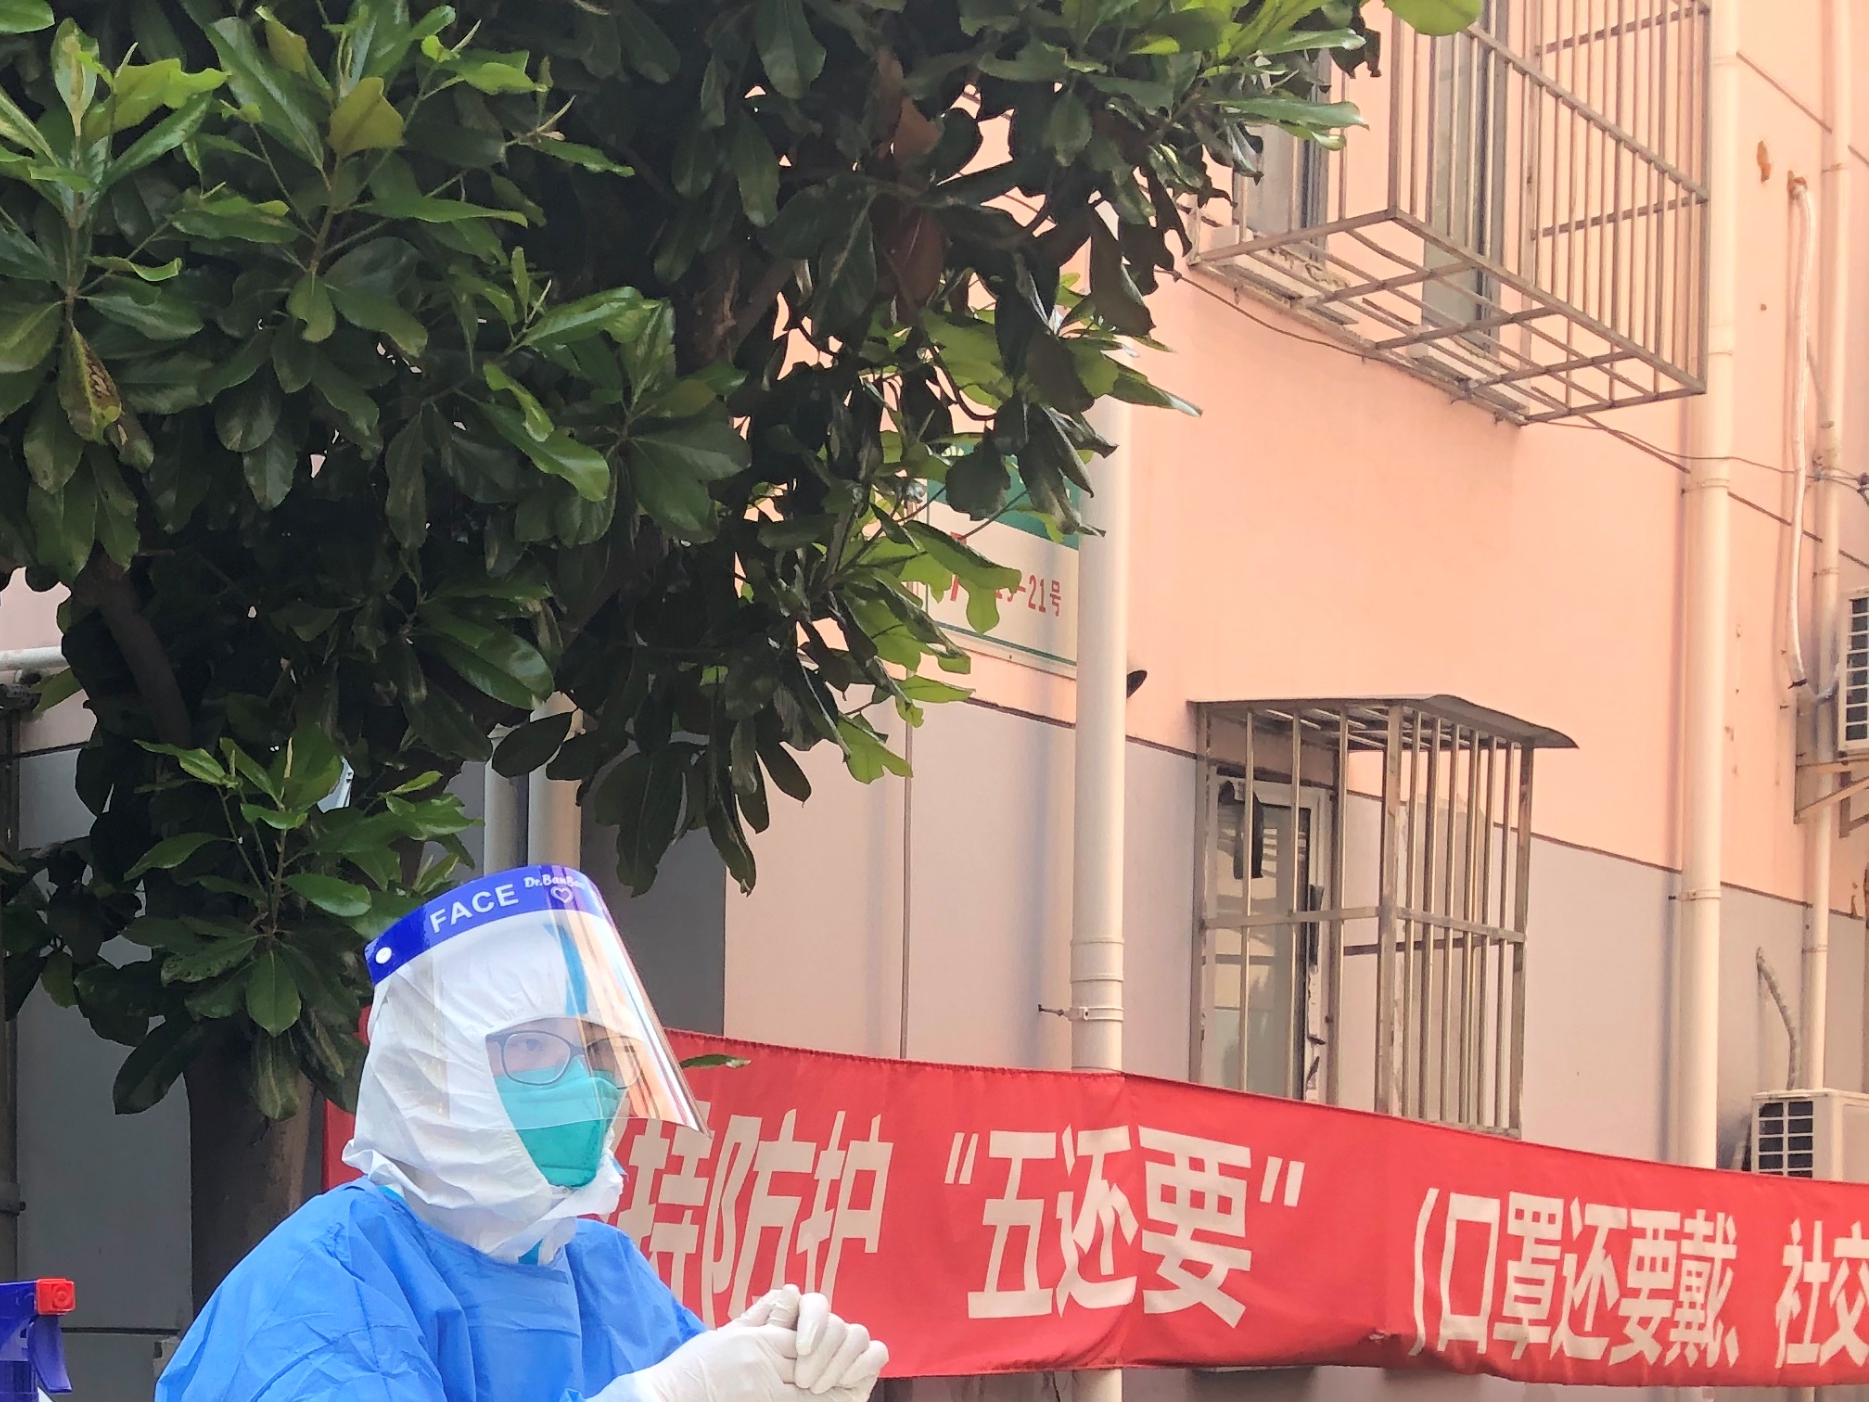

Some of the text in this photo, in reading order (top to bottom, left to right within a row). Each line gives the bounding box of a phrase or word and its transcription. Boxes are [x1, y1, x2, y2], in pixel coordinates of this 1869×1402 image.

[430, 883, 520, 933] FACE
[610, 1100, 894, 1330] 持防护
